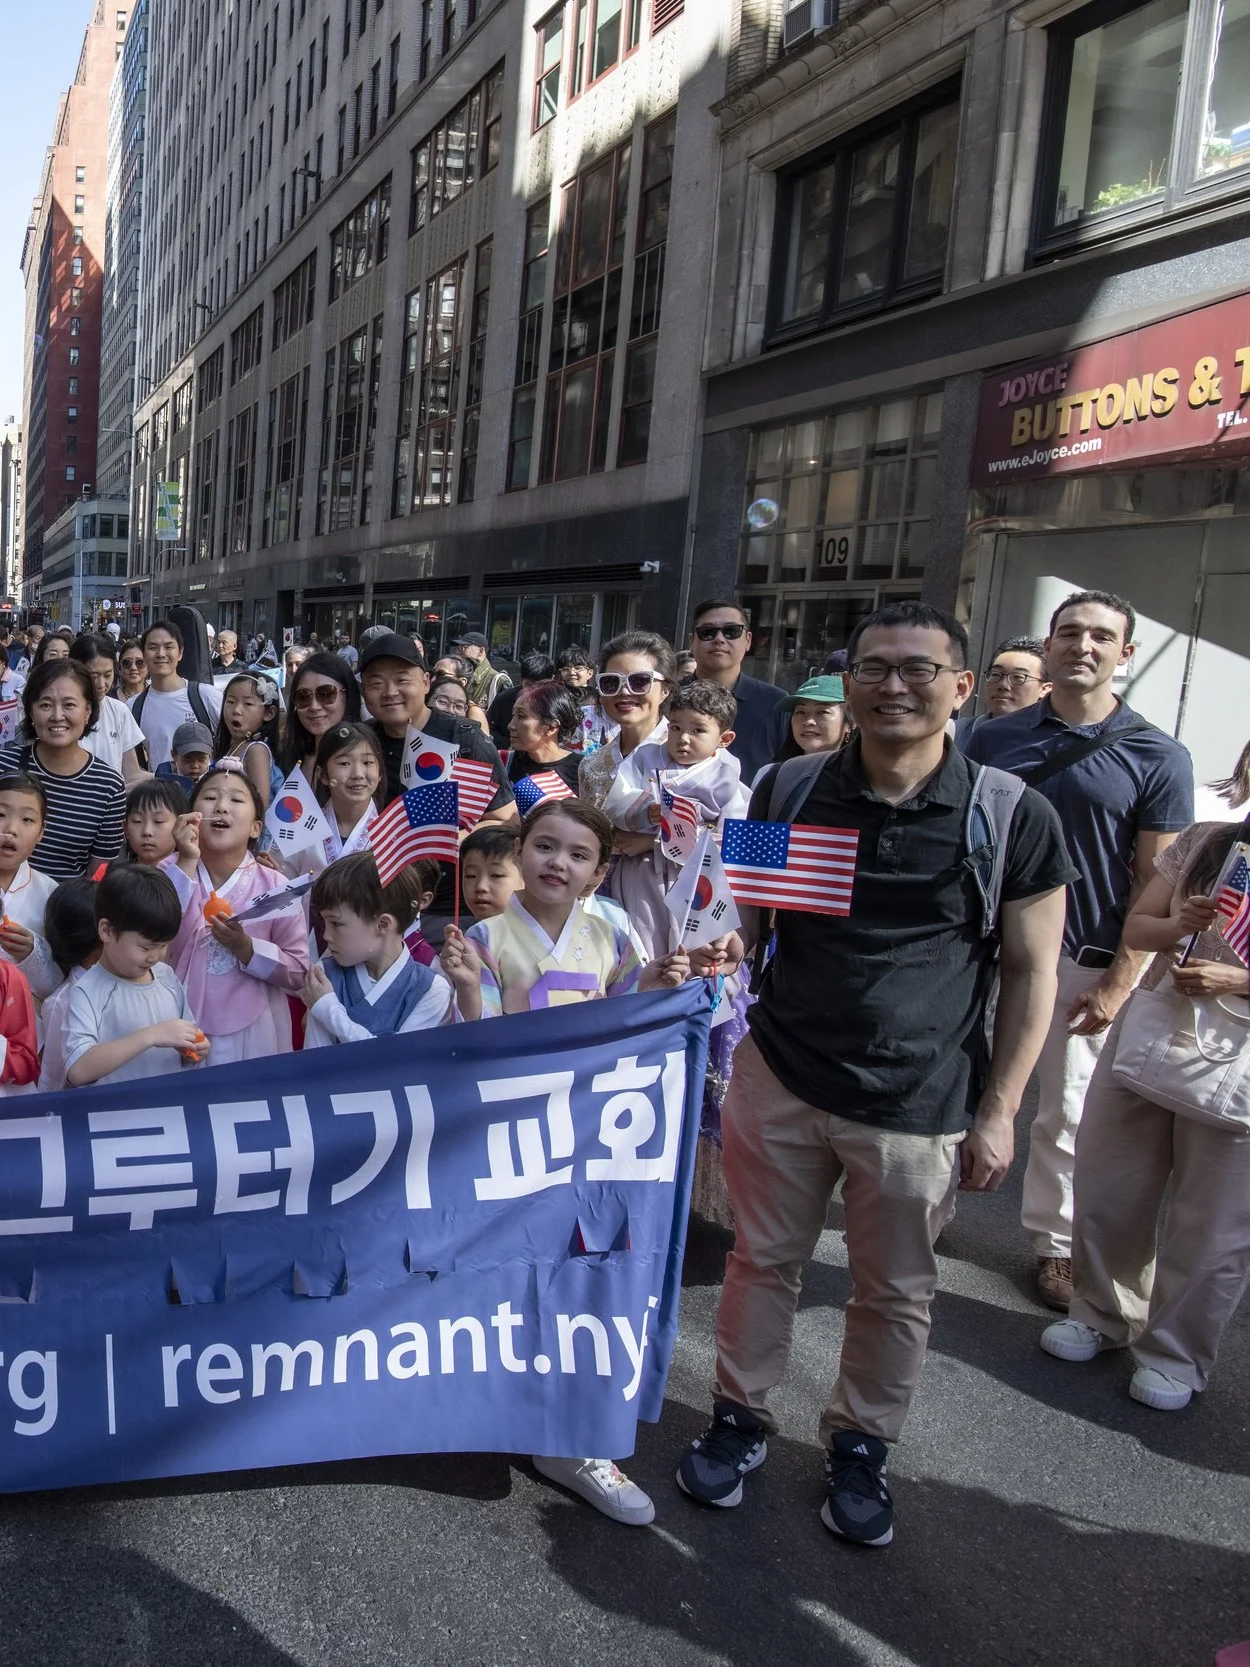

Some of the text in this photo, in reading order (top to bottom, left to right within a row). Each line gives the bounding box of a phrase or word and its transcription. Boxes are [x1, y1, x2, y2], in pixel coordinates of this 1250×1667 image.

[998, 363, 1067, 407] JOYCE
[1011, 368, 1179, 448] BUTTONS
[1188, 356, 1223, 409] &
[1217, 410, 1248, 428] TEL.
[988, 437, 1102, 472] www.eJoyce.com
[817, 536, 849, 565] 109
[473, 1050, 686, 1202] 교회
